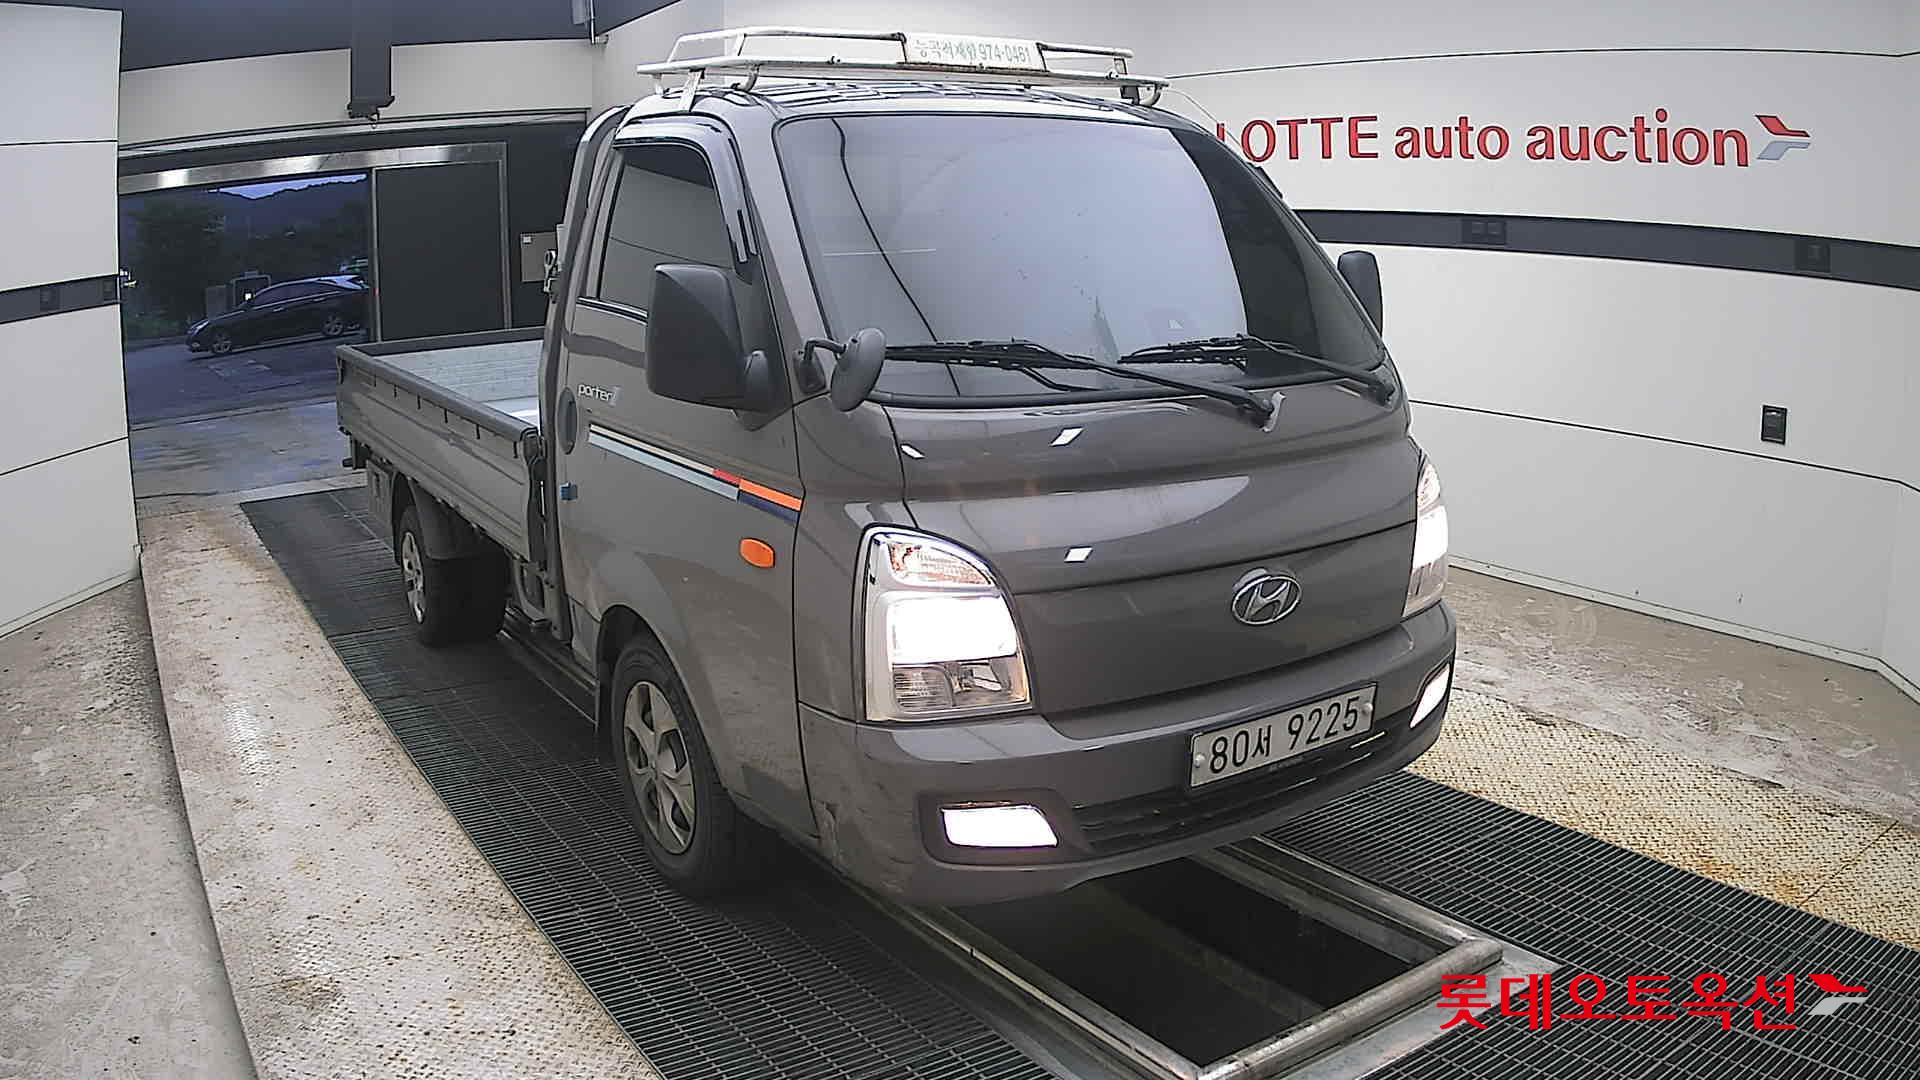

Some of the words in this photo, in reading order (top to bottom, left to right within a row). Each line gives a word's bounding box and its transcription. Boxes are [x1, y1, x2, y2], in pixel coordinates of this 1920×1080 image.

[1216, 115, 1379, 163] OTTE
[1394, 115, 1510, 160] auto
[1526, 108, 1750, 167] auction
[1209, 724, 1272, 774] 80서
[1287, 696, 1360, 750] 9225
